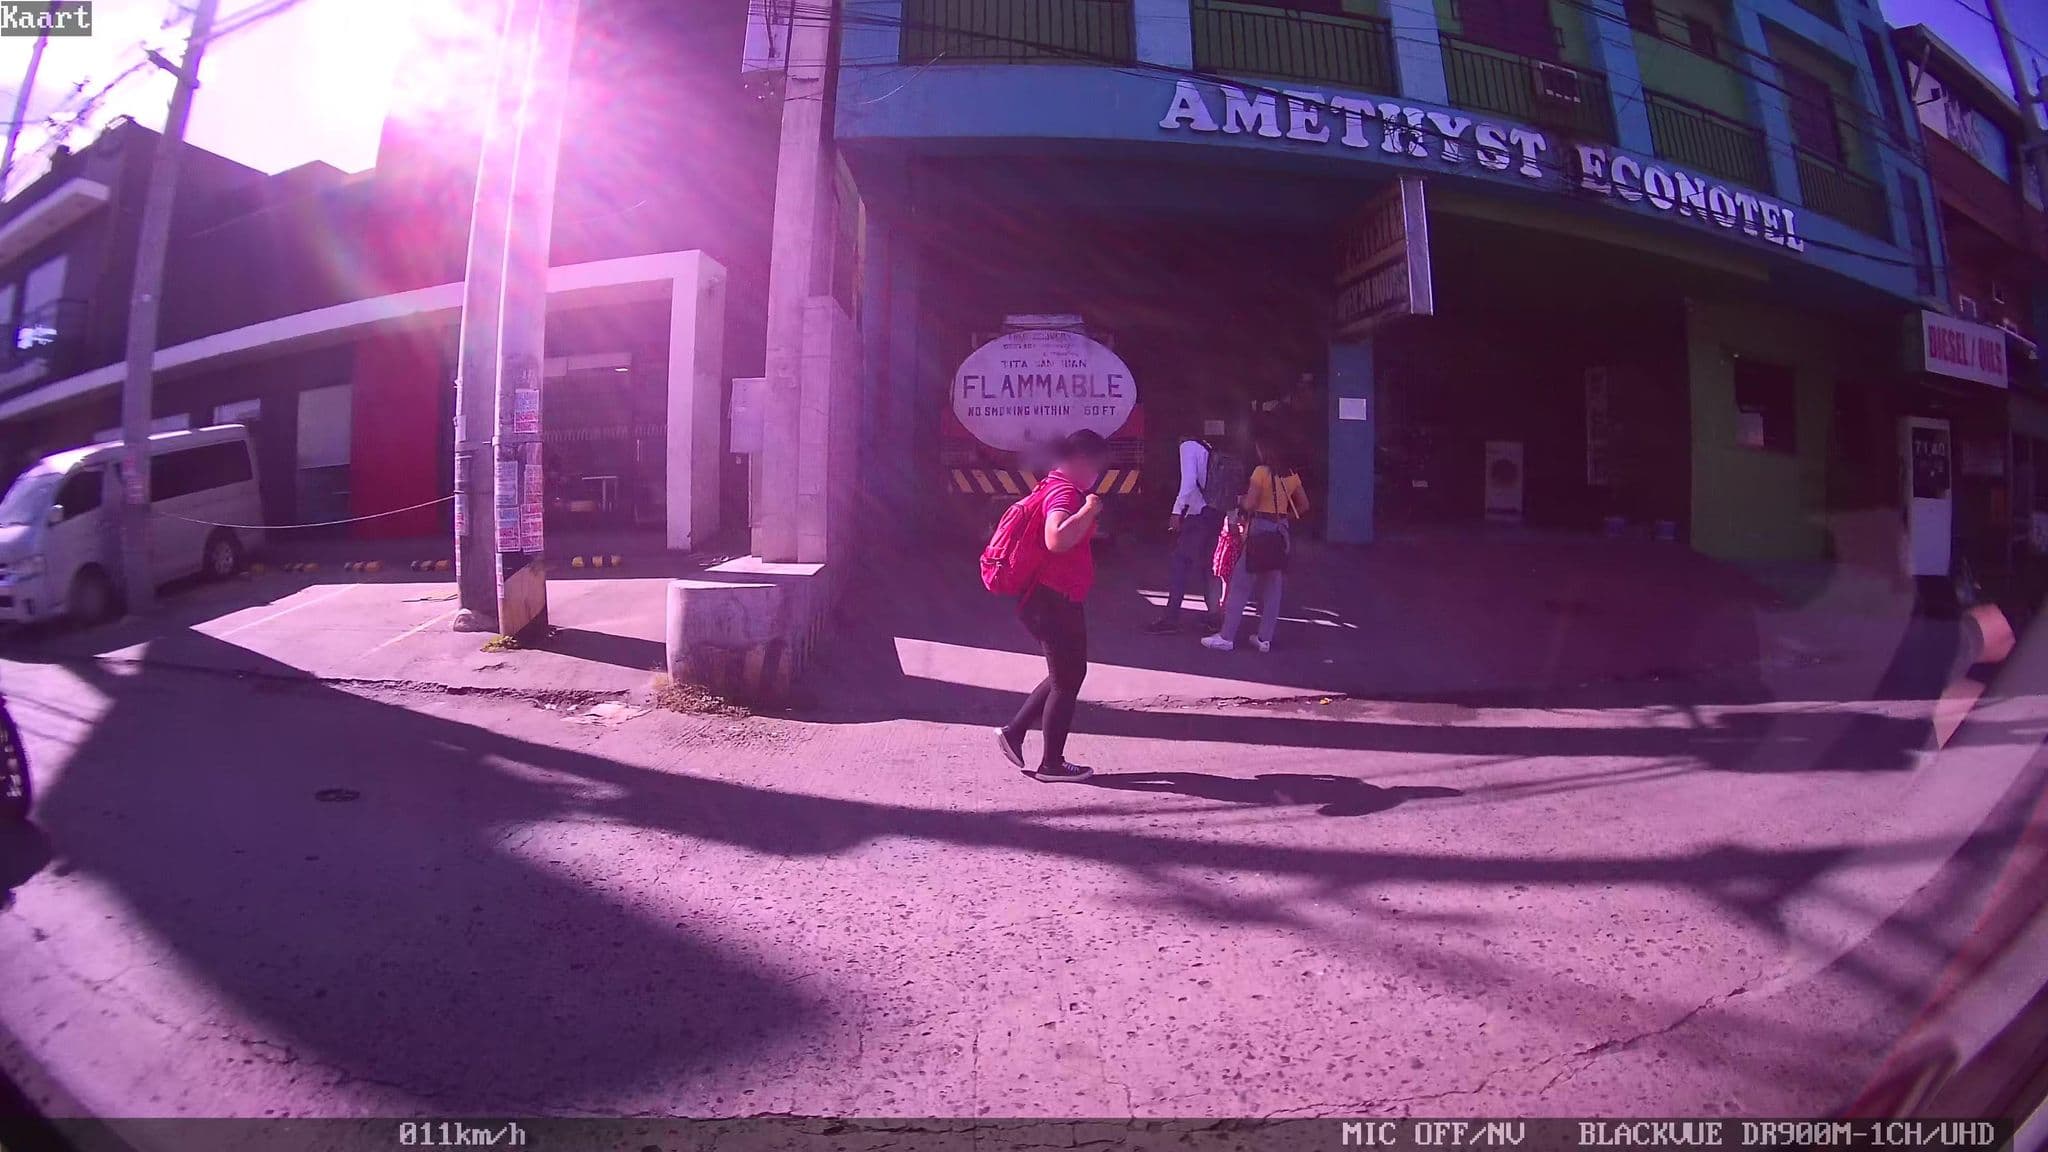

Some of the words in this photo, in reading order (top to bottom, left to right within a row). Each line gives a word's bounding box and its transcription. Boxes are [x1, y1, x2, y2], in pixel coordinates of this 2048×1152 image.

[1158, 78, 1547, 178] AMETHYST
[1576, 143, 1804, 252] ECONOTEL
[1928, 324, 1968, 366] DIESEL
[1979, 336, 2003, 375] OILS
[963, 374, 1123, 399] FLAMMABLE
[968, 406, 981, 417] NO
[984, 406, 1030, 417] SMOKING
[1034, 405, 1070, 416] WITHIN
